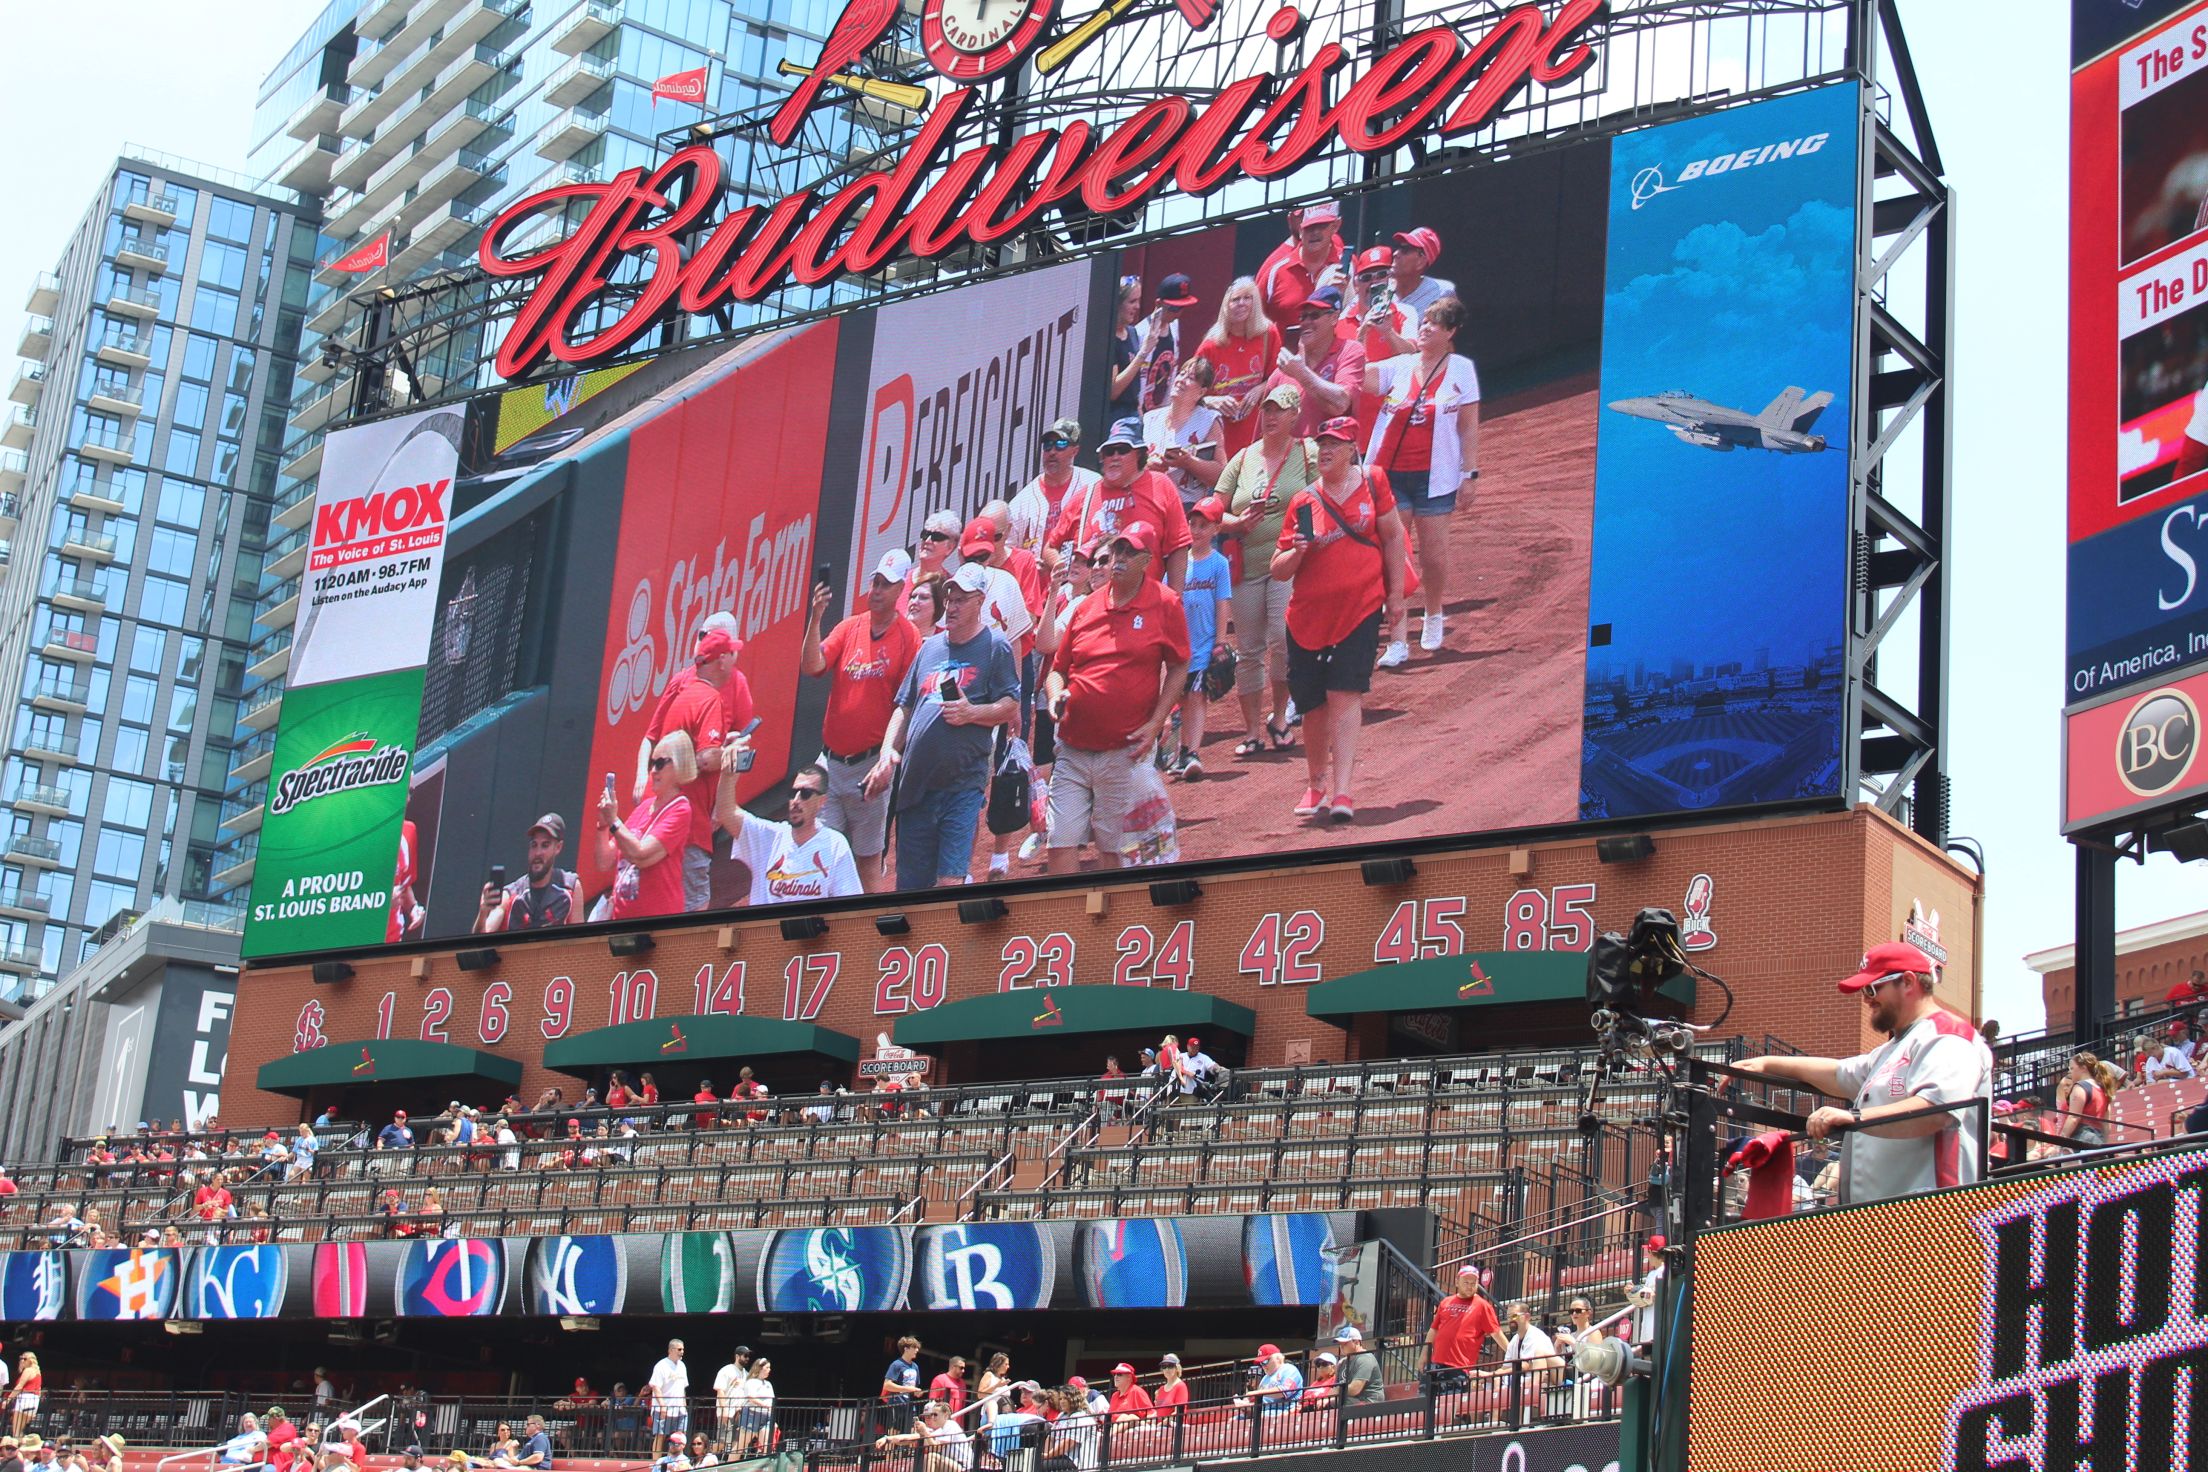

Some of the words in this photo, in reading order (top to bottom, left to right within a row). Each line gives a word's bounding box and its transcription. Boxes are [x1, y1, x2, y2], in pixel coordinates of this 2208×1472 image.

[944, 0, 1027, 49] CARDINAL
[2137, 45, 2184, 89] The
[1676, 132, 1830, 183] BOEING
[478, 0, 1608, 380] Budweiser
[2136, 277, 2184, 320] The
[313, 478, 452, 548] KMOX
[313, 551, 334, 567] The
[337, 545, 369, 563] Voice
[372, 541, 386, 555] of
[389, 537, 406, 552] St.
[408, 530, 441, 548] Louis
[2158, 504, 2208, 611] S
[311, 592, 340, 607] Listen
[341, 591, 353, 602] on
[354, 586, 370, 600] the
[370, 580, 407, 597] Audacy
[408, 576, 428, 593] App
[2073, 665, 2096, 692] Of
[2098, 646, 2182, 686] America,
[2125, 711, 2189, 774] BC
[271, 744, 409, 815] Spectracide
[254, 903, 275, 921] ST.
[278, 897, 327, 918] LOUIS
[329, 891, 386, 913] BRAND
[282, 878, 295, 898] A
[299, 870, 364, 897] PROUD
[769, 879, 822, 898] Cardinals
[1683, 917, 1711, 932] BUCK
[1907, 929, 1948, 962] SCOREBOARD
[377, 991, 396, 1040] 1
[420, 987, 453, 1044] 2
[478, 981, 513, 1044] 6
[540, 975, 576, 1040] 9
[609, 968, 660, 1027] 10
[694, 960, 747, 1017] 14
[783, 951, 842, 1022] 17
[873, 942, 949, 1015] 20
[998, 931, 1077, 993] 23
[1113, 919, 1196, 991] 24
[1237, 909, 1326, 986] 42
[1374, 895, 1468, 964] 45
[1503, 882, 1597, 953] 85
[861, 1060, 926, 1073] SCOREBOARD
[199, 1245, 260, 1319] KC
[1991, 1168, 2208, 1382] HO
